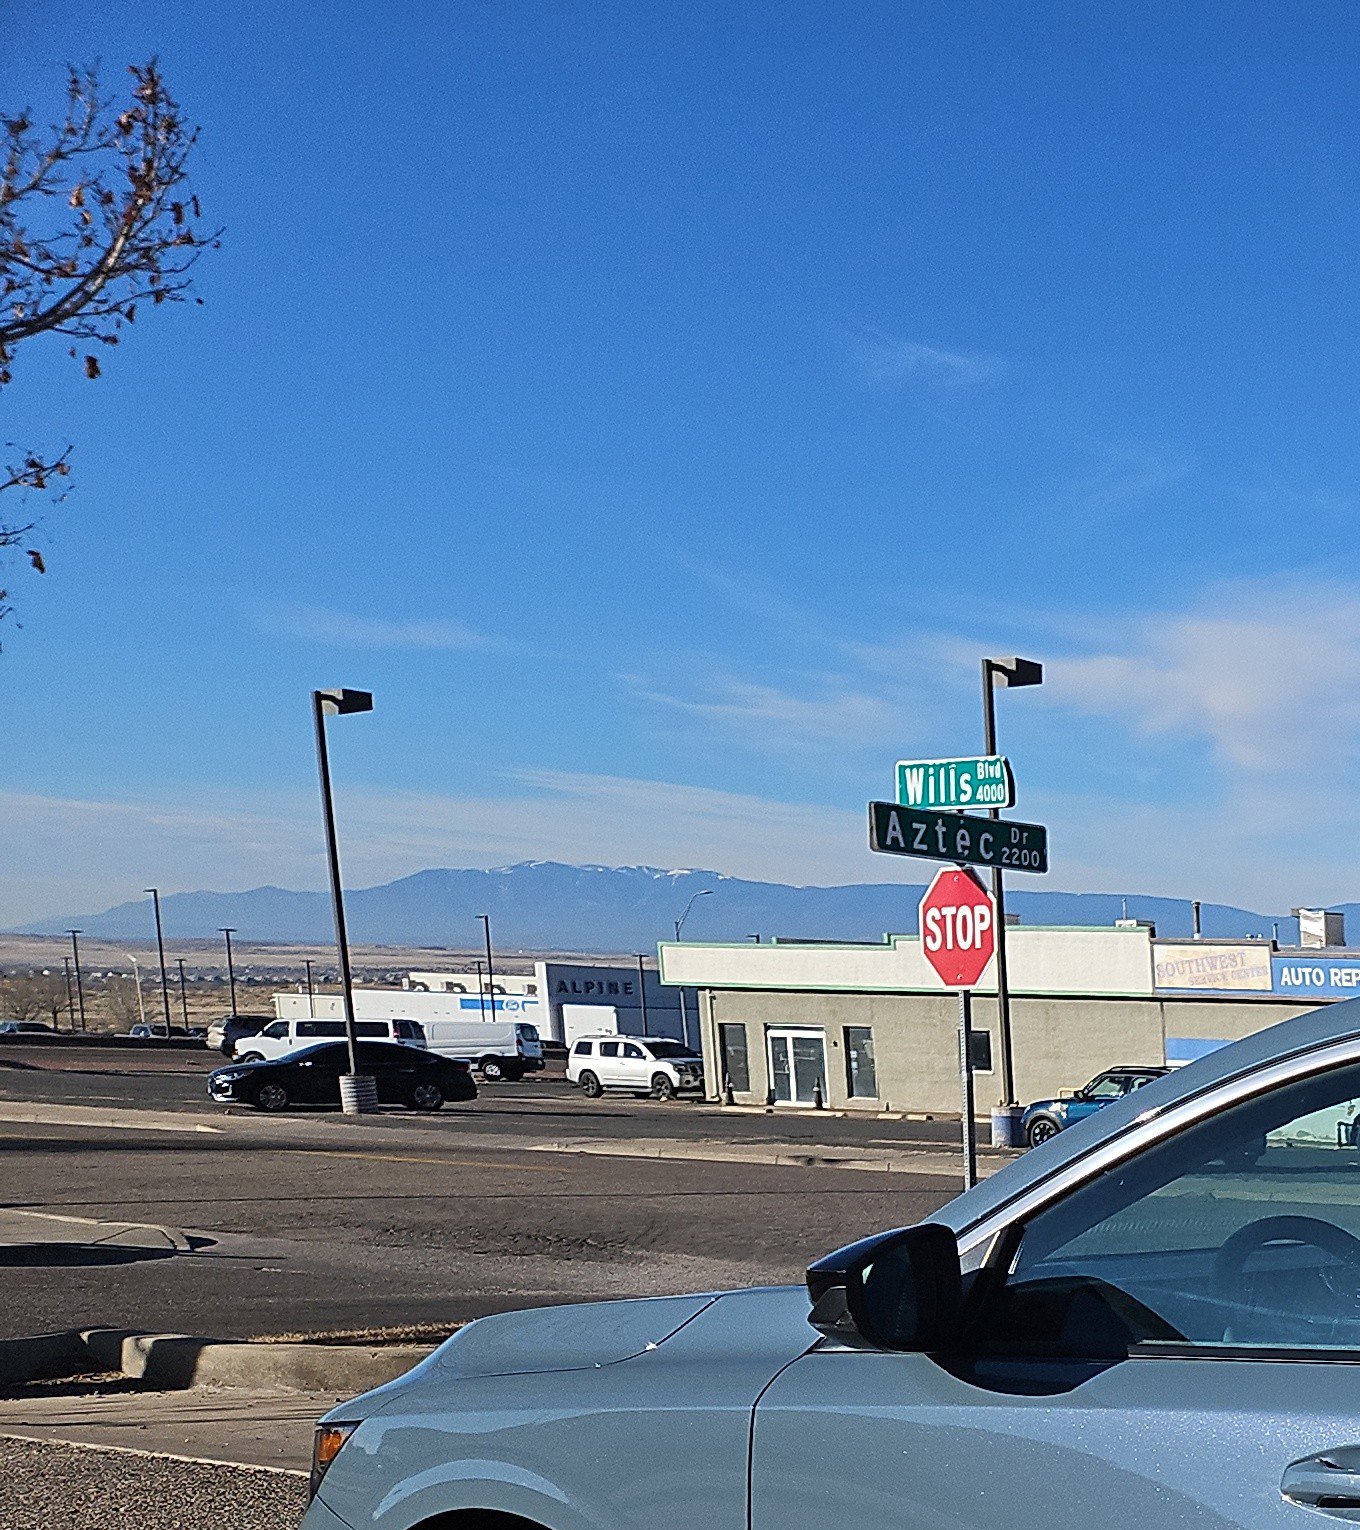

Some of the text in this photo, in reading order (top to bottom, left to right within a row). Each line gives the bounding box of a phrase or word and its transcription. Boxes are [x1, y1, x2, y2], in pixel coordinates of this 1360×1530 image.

[905, 761, 1001, 805] Wills Blvd
[976, 783, 1004, 802] 4000
[886, 811, 1029, 859] Aztec Dr
[1001, 848, 1040, 867] 2200
[925, 905, 991, 951] STOP
[1156, 951, 1247, 979] SOUTHWEST
[1281, 967, 1325, 986] AUTO
[557, 980, 635, 995] ALPINE
